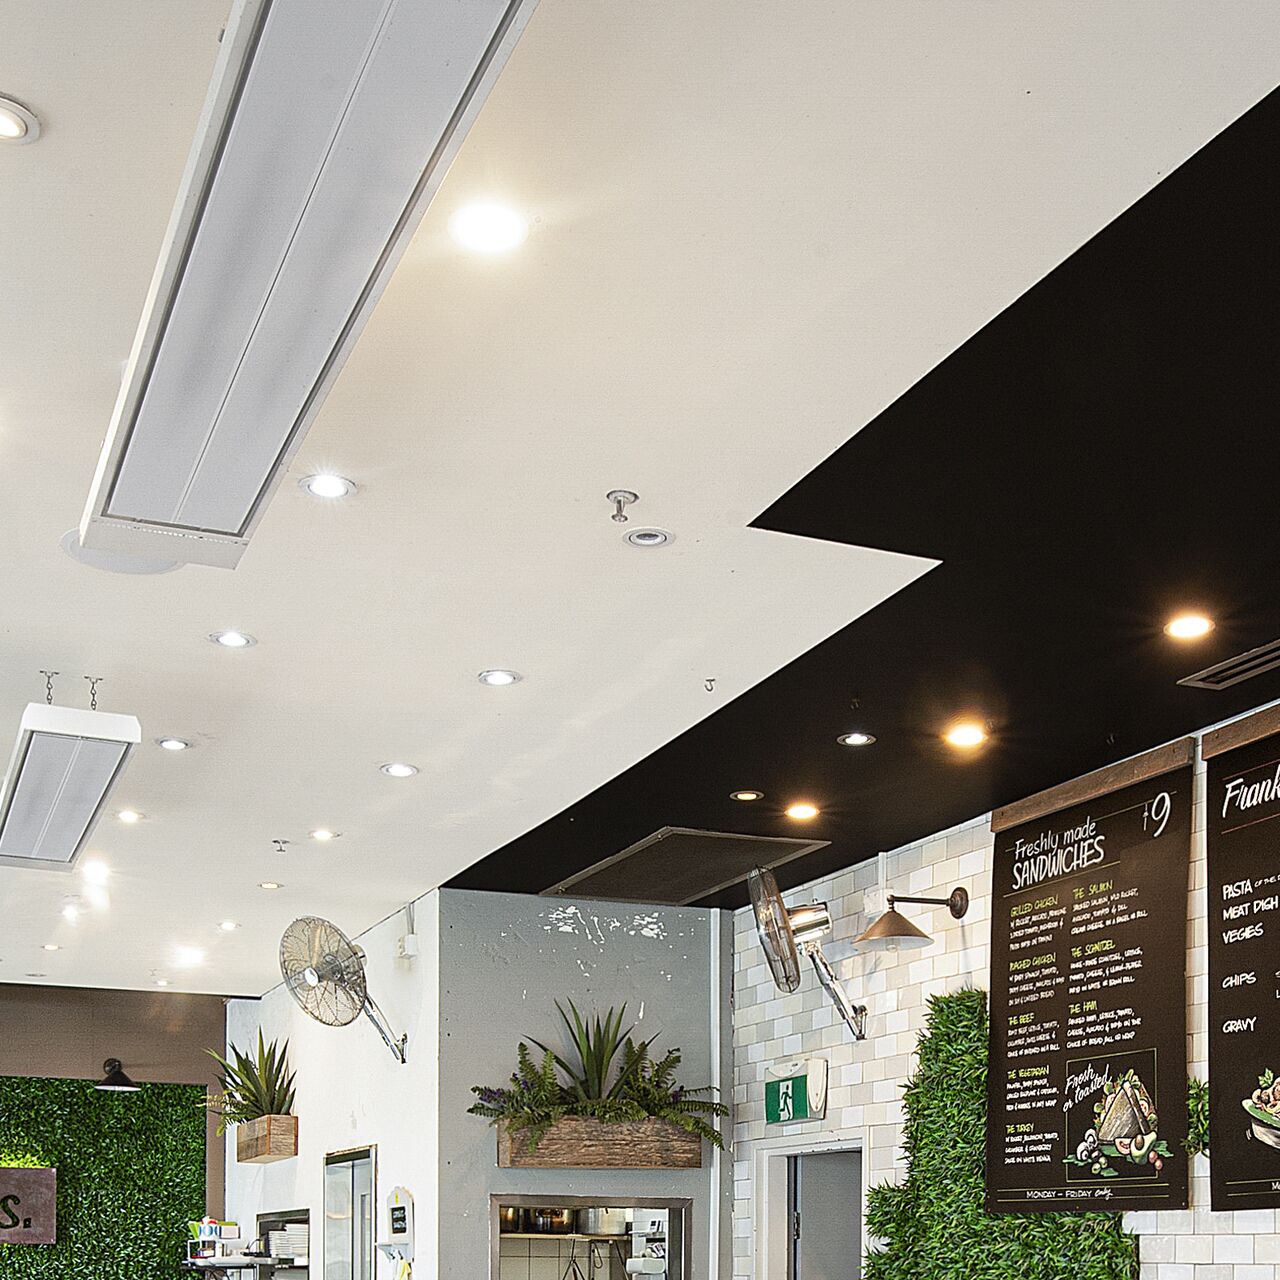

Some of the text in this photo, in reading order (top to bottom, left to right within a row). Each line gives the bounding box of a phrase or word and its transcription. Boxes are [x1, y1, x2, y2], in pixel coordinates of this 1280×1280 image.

[1015, 815, 1096, 861] Freshly made
[1012, 835, 1105, 890] SANDWICHES
[1222, 878, 1253, 901] PASTA
[1223, 895, 1279, 921] MEAT DISH
[1222, 922, 1264, 945] VEGIES
[1222, 971, 1257, 989] CHIPS
[1222, 1016, 1257, 1033] GRAVY
[1064, 1063, 1096, 1096] Fresh
[1074, 1063, 1113, 1103] toasted
[1026, 1189, 1092, 1199] MONDAY FRIDAY
